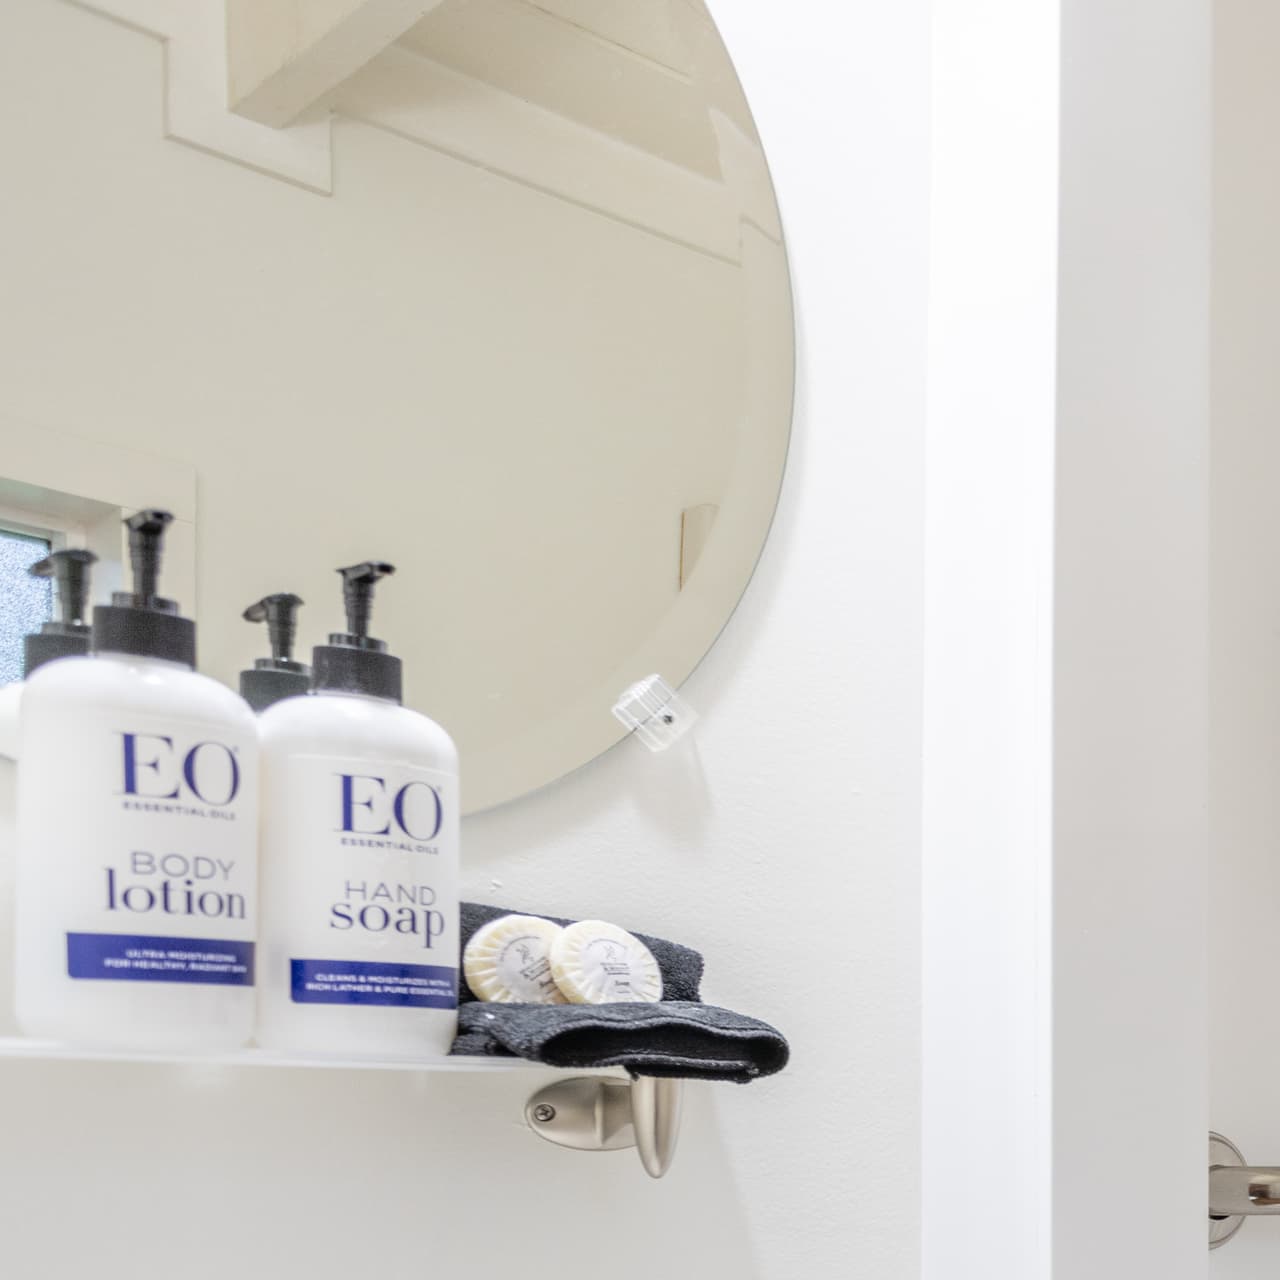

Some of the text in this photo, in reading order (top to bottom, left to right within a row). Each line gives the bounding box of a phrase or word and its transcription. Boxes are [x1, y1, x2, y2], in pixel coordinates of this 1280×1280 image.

[112, 732, 240, 806] EO
[123, 801, 206, 818] ESSENTIAL
[332, 772, 443, 842] EO
[340, 837, 413, 853] ESSENTIAL
[130, 851, 236, 881] BODY
[104, 867, 247, 919] lotion
[344, 880, 438, 906] HAND
[329, 902, 446, 949] soap
